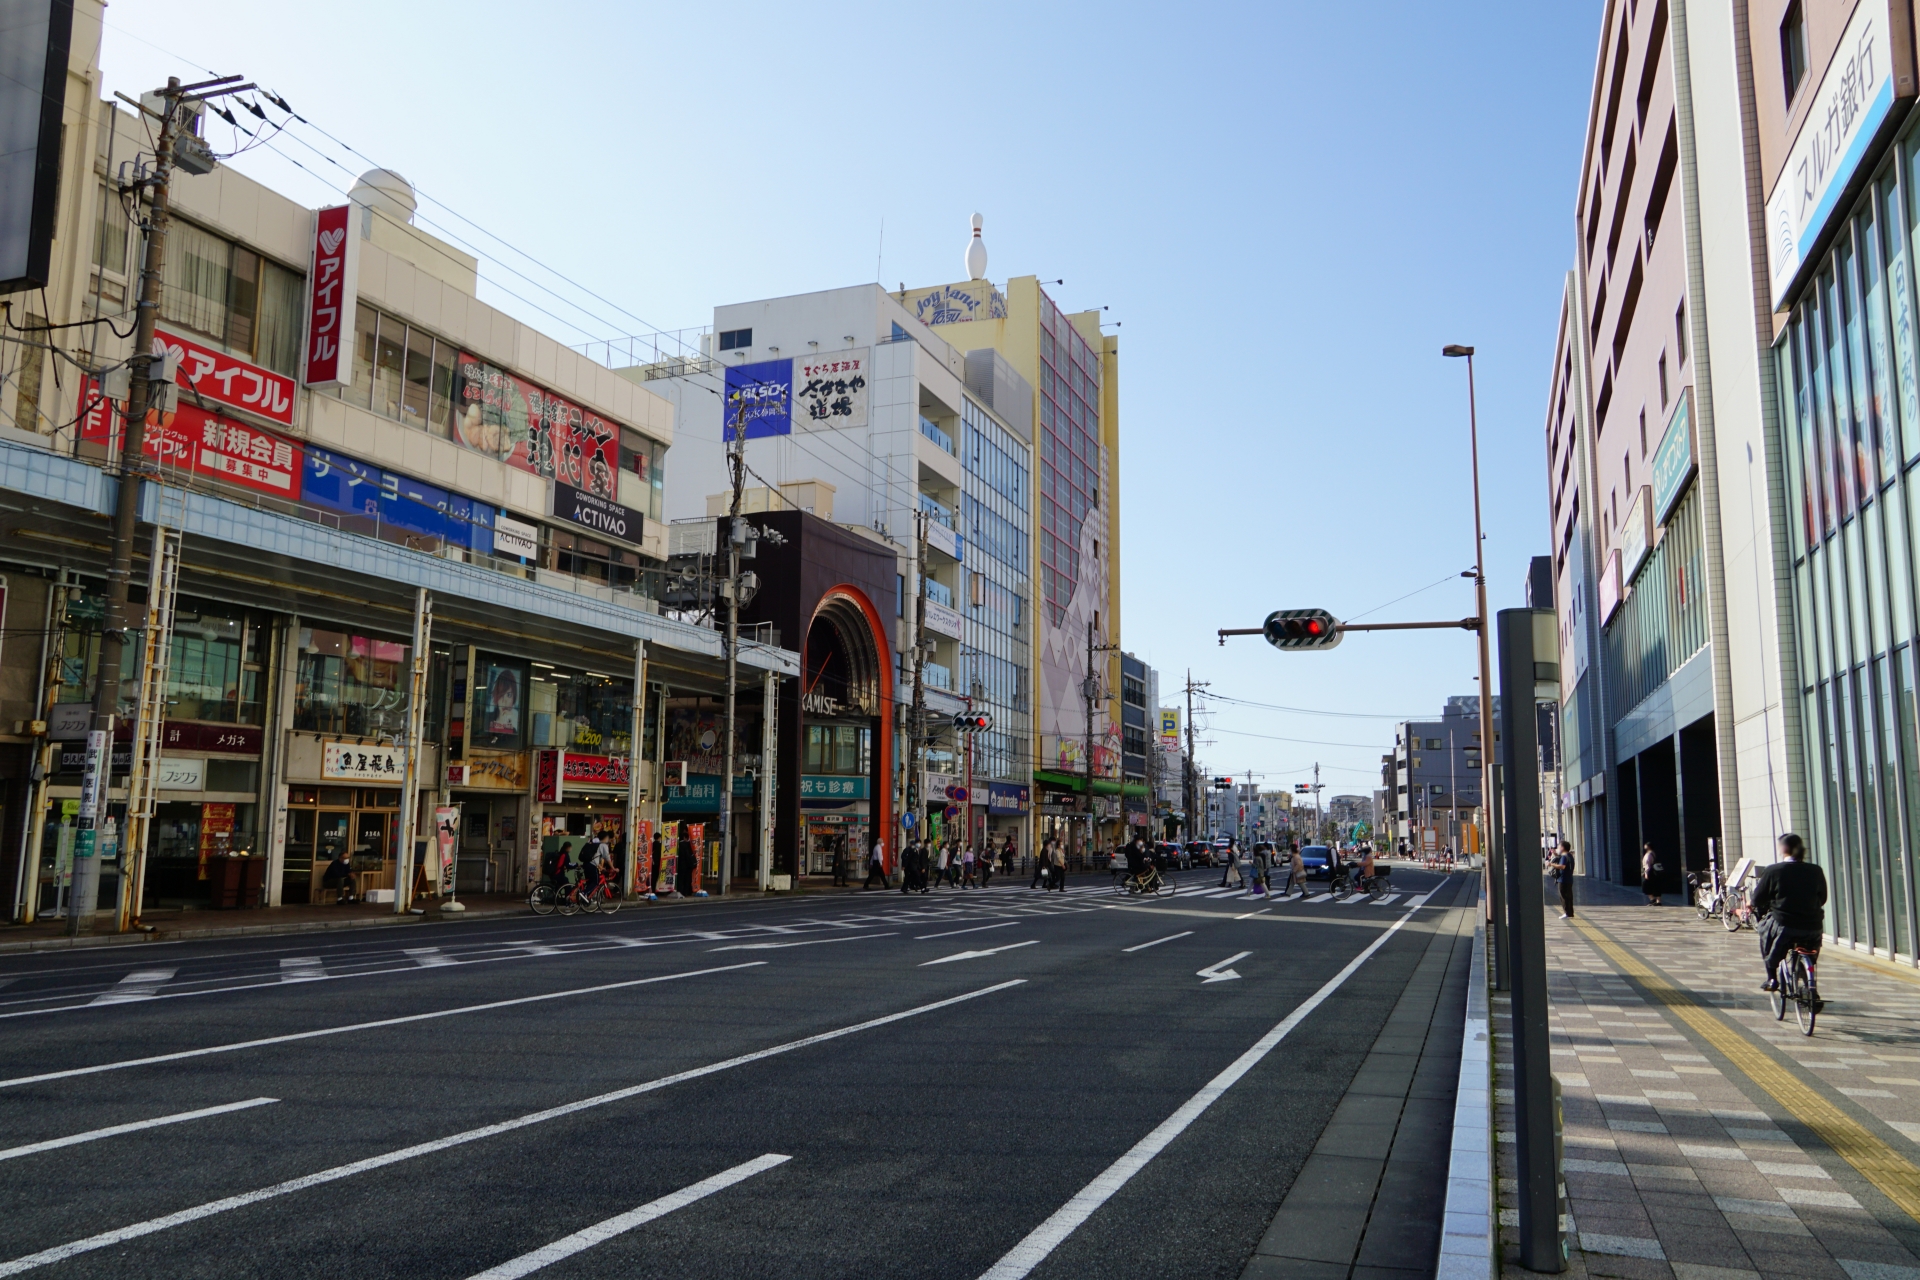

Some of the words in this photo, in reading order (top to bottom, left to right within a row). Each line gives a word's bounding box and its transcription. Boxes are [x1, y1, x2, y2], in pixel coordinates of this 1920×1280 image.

[1798, 18, 1874, 222] スルガ銀行
[312, 258, 338, 362] アイフル
[917, 291, 941, 317] Joy
[944, 285, 981, 312] land
[804, 360, 860, 377] まぐろ居酒屋
[187, 349, 290, 414] アイフル
[799, 375, 866, 399] さかなや
[810, 396, 853, 420] 道場
[203, 418, 293, 471] 新規会員
[226, 458, 269, 481] 募集中
[311, 451, 423, 501] サンヨー
[436, 500, 488, 525] クレジット
[575, 491, 608, 509] COWORKING
[608, 503, 626, 517] SPACE
[573, 504, 627, 536] ACTIVAO
[500, 533, 532, 550] ACTIVAO
[57, 720, 86, 731] フジワラ
[1163, 720, 1175, 734] P
[216, 734, 246, 747] メガネ
[160, 771, 198, 785] フジワラ
[540, 752, 550, 794] ラーメン
[669, 784, 715, 798] 沼津歯科
[801, 780, 855, 794] 祝も診療
